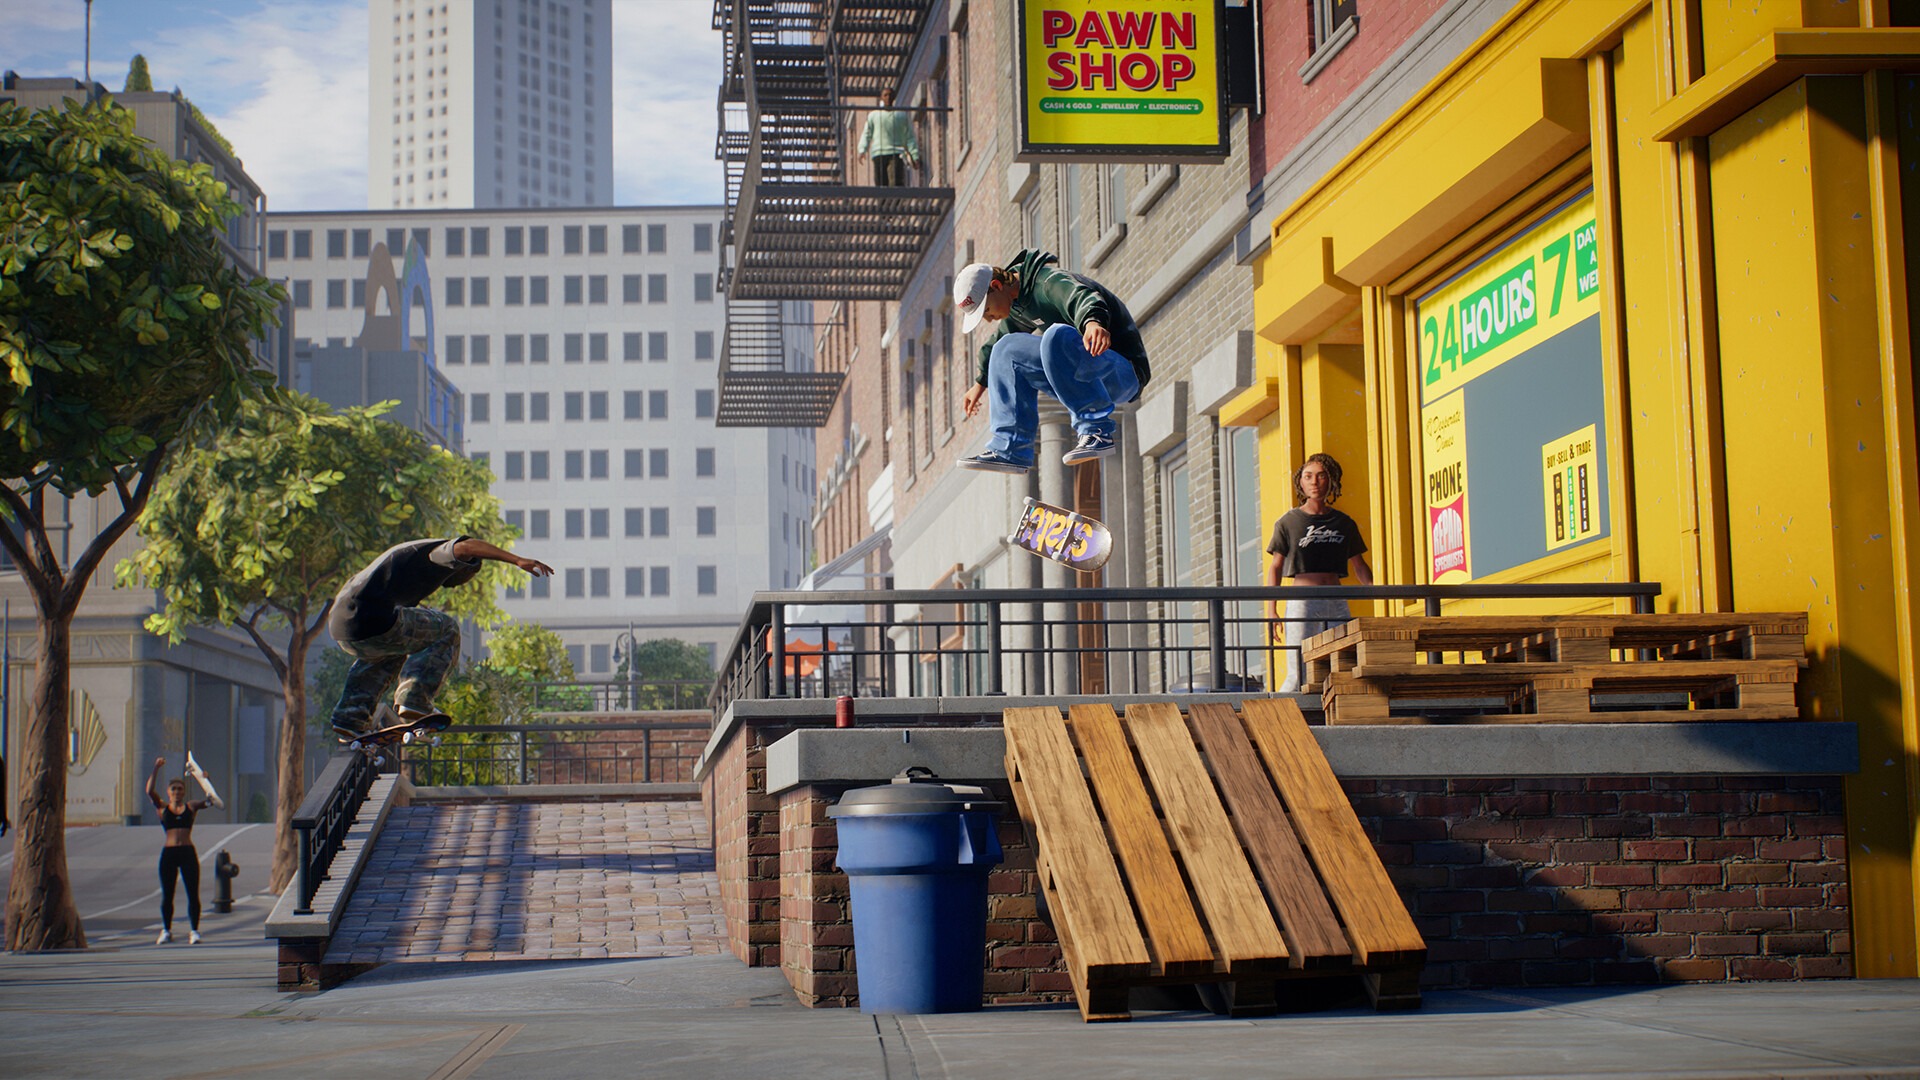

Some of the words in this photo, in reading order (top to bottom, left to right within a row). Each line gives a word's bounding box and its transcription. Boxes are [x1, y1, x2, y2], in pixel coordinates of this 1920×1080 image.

[1042, 10, 1195, 49] PAWN
[1047, 52, 1195, 90] SHOP
[1589, 249, 1597, 265] A
[1424, 303, 1459, 387] 24
[1461, 269, 1535, 355] HOURS
[1542, 232, 1570, 319] 7
[1569, 443, 1575, 460] &
[1576, 440, 1592, 457] TRADE
[1430, 461, 1462, 504] PHONE
[1580, 467, 1588, 531] SILVER
[1555, 475, 1563, 539] GOLD
[1433, 507, 1463, 556] REPAIR
